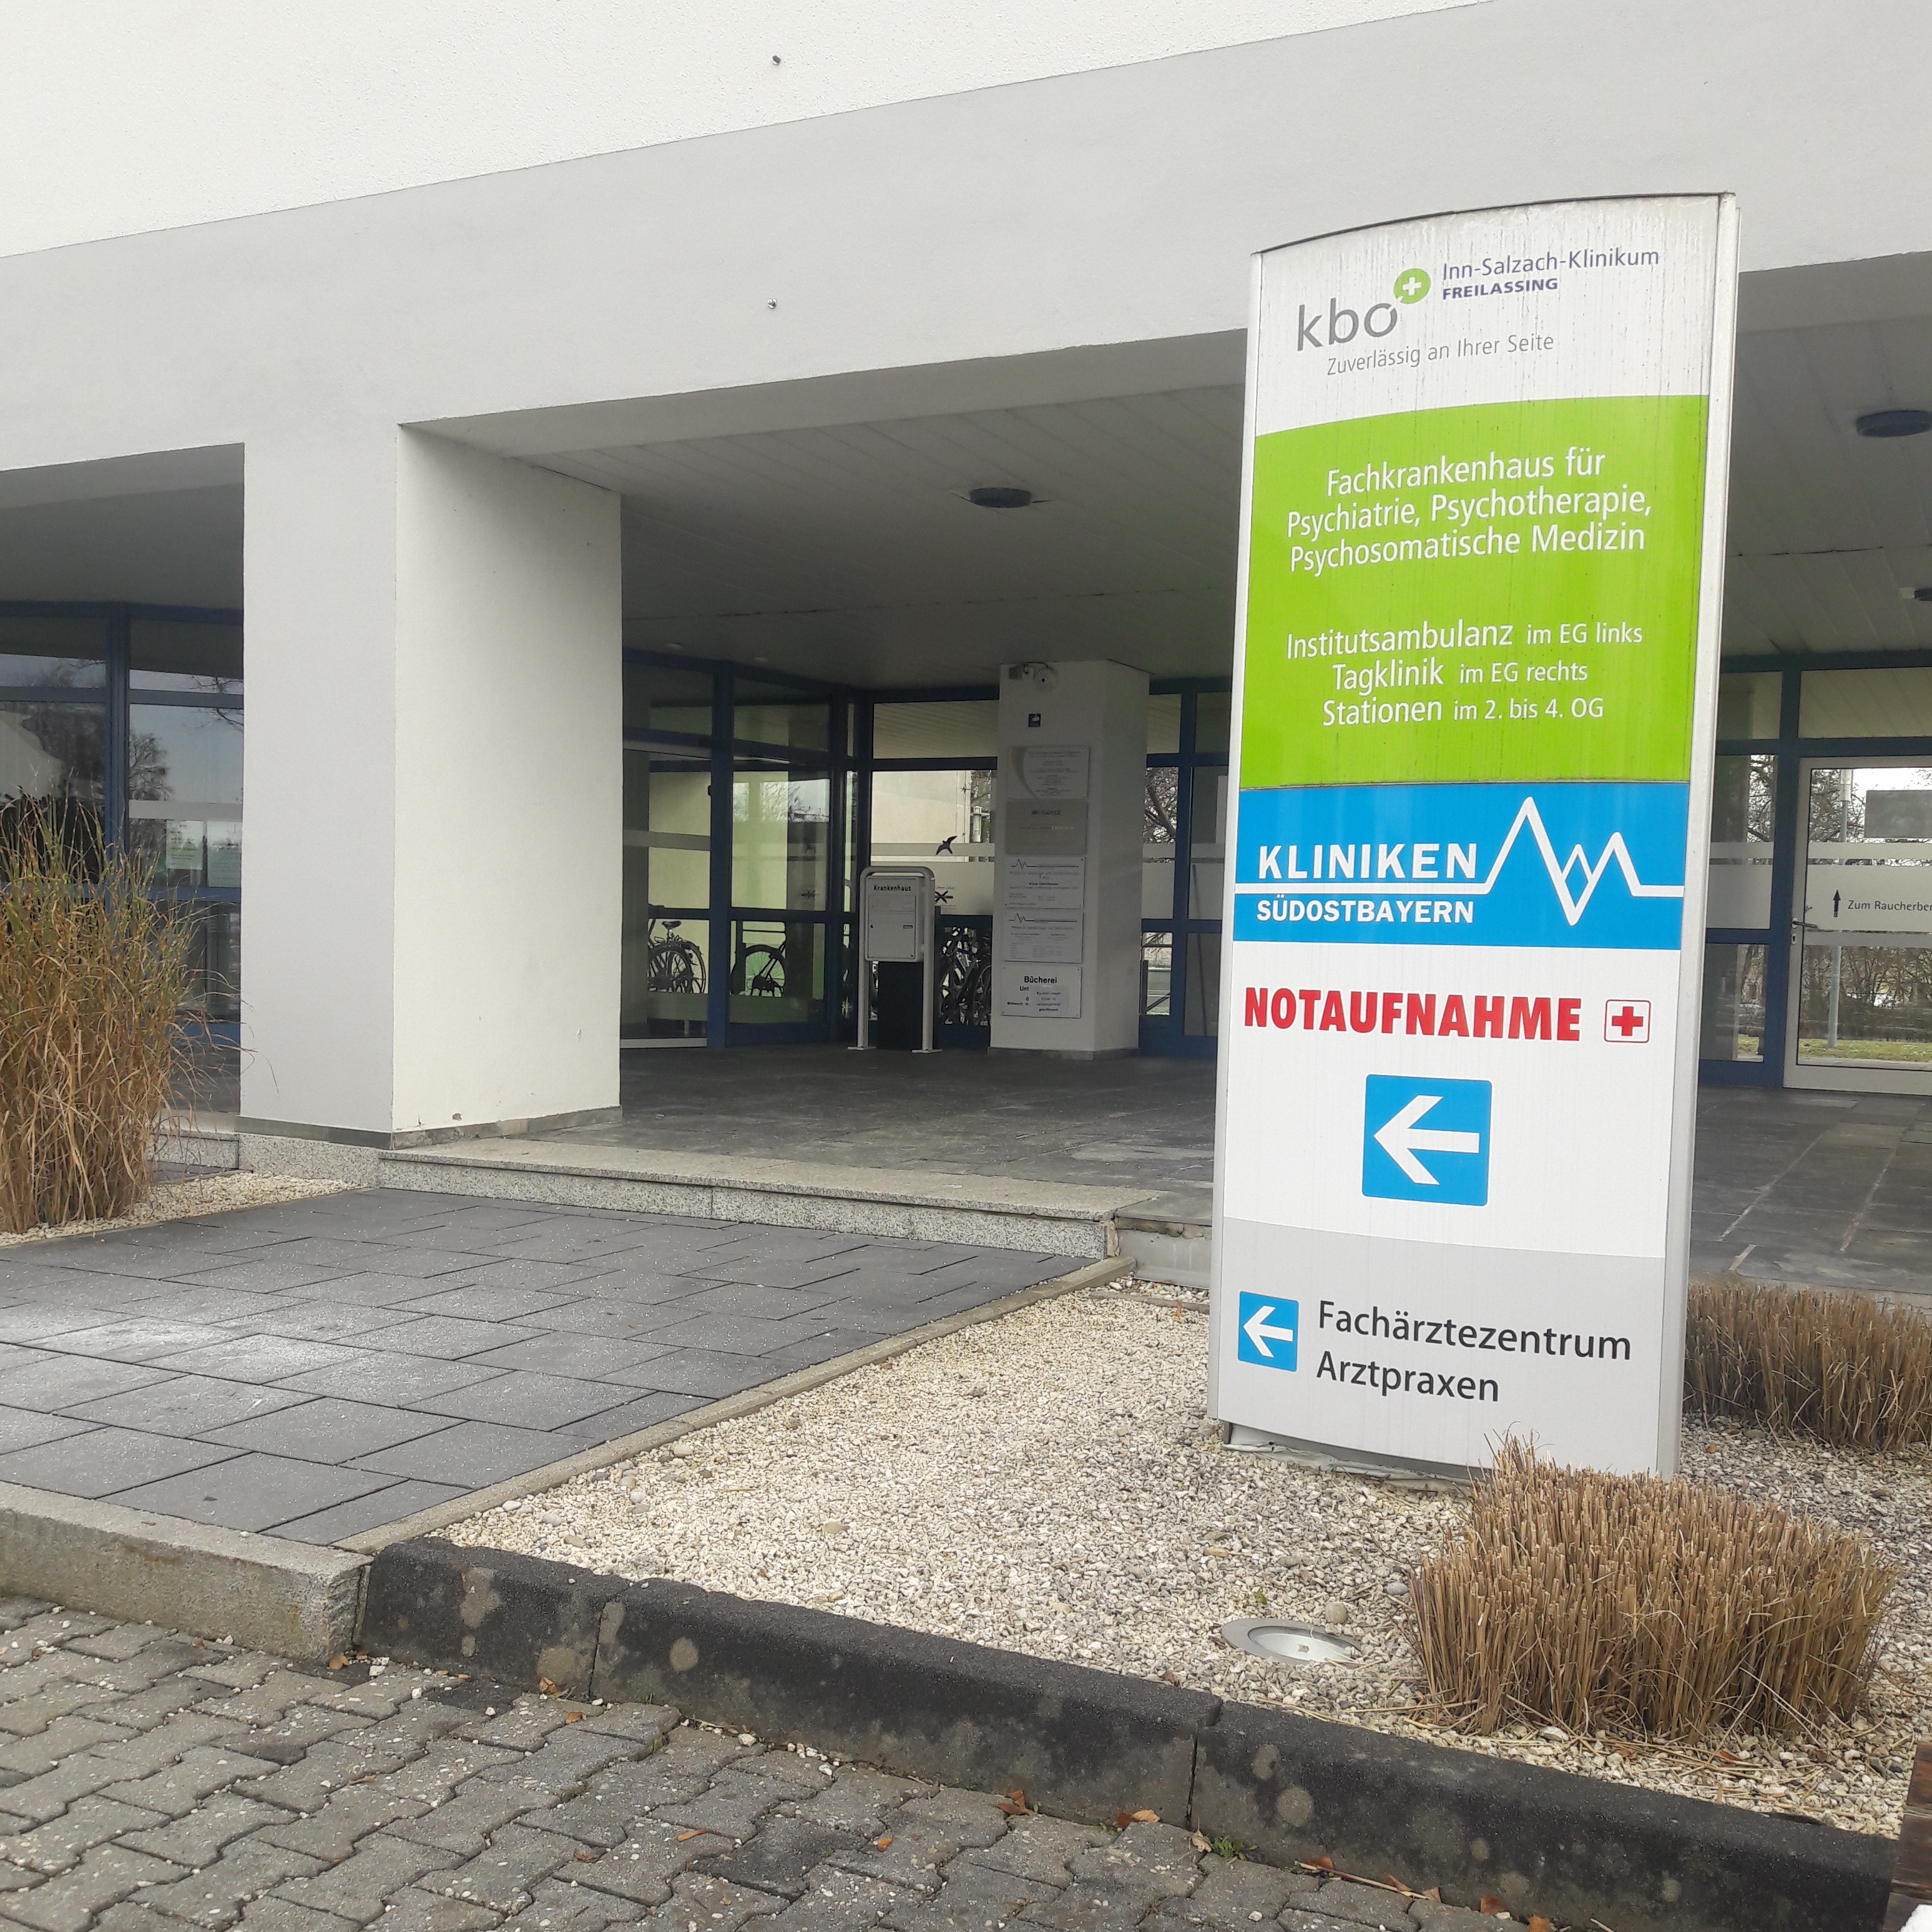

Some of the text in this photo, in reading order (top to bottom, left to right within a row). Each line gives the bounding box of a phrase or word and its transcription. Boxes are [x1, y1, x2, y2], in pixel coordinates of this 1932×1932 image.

[1443, 247, 1659, 280] Inn-Salzach-Klinikum
[1443, 277, 1559, 300] FREILASSING
[1297, 297, 1398, 351] kbo
[1326, 333, 1554, 375] Zuverlässig an Ihrer Seite
[1327, 446, 1606, 497] Fachkrankenhaus für
[1287, 484, 1651, 542] Psychiatrie, Psychotherapie,
[1290, 522, 1645, 577] Psychosomatische Medizin
[1287, 619, 1643, 659] Institutsambulanz im EG links
[1333, 656, 1588, 696] Tagklinik im EG rechts
[1323, 697, 1604, 727] Stationen im 2. bis 4. OG
[1258, 843, 1478, 880] KLINIKEN
[873, 884, 911, 892] Krankenhaus
[1848, 900, 1871, 910] Zum
[1257, 895, 1474, 924] SÜDOSTBAYERN
[1024, 976, 1057, 984] Bücherei
[1244, 987, 1582, 1042] NOTAUFNAHME
[1318, 1300, 1632, 1360] Fachärztezentrum
[1317, 1350, 1499, 1402] Arztpraxen
